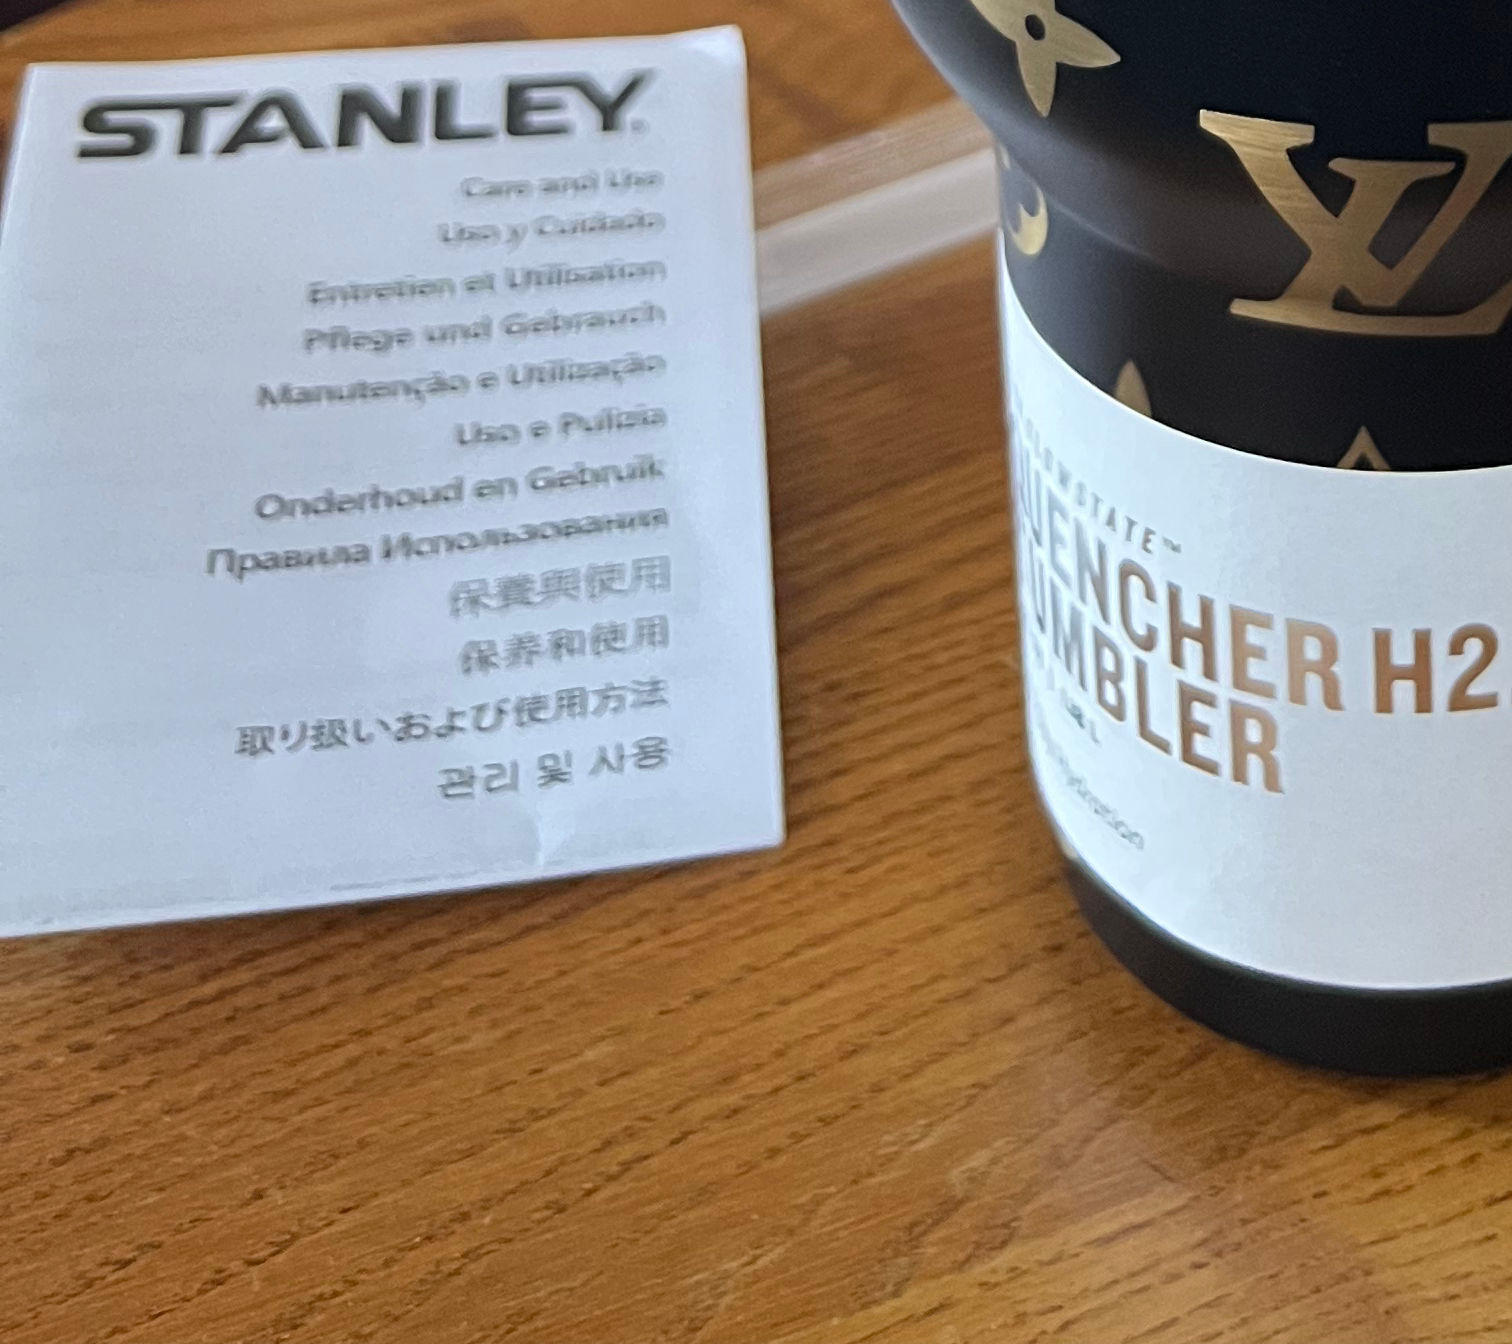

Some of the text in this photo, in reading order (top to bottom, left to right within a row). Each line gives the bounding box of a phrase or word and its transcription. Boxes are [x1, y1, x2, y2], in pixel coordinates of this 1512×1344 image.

[460, 168, 665, 198] Care and Use
[437, 221, 499, 246] Uso
[532, 210, 666, 238] Cuidado
[306, 259, 667, 307] Entretien et Utilisation
[304, 302, 667, 354] Pflege und Gebrauch
[257, 372, 470, 408] Manutenção
[475, 370, 500, 390] e
[456, 421, 521, 448] Uso
[528, 419, 552, 439] e
[254, 452, 666, 521] Onderhoud en Gebruik
[205, 507, 669, 582] Правила Использования
[234, 676, 672, 759] 取り扱いおよび使用方法
[437, 734, 672, 800] 관리 및 사용
